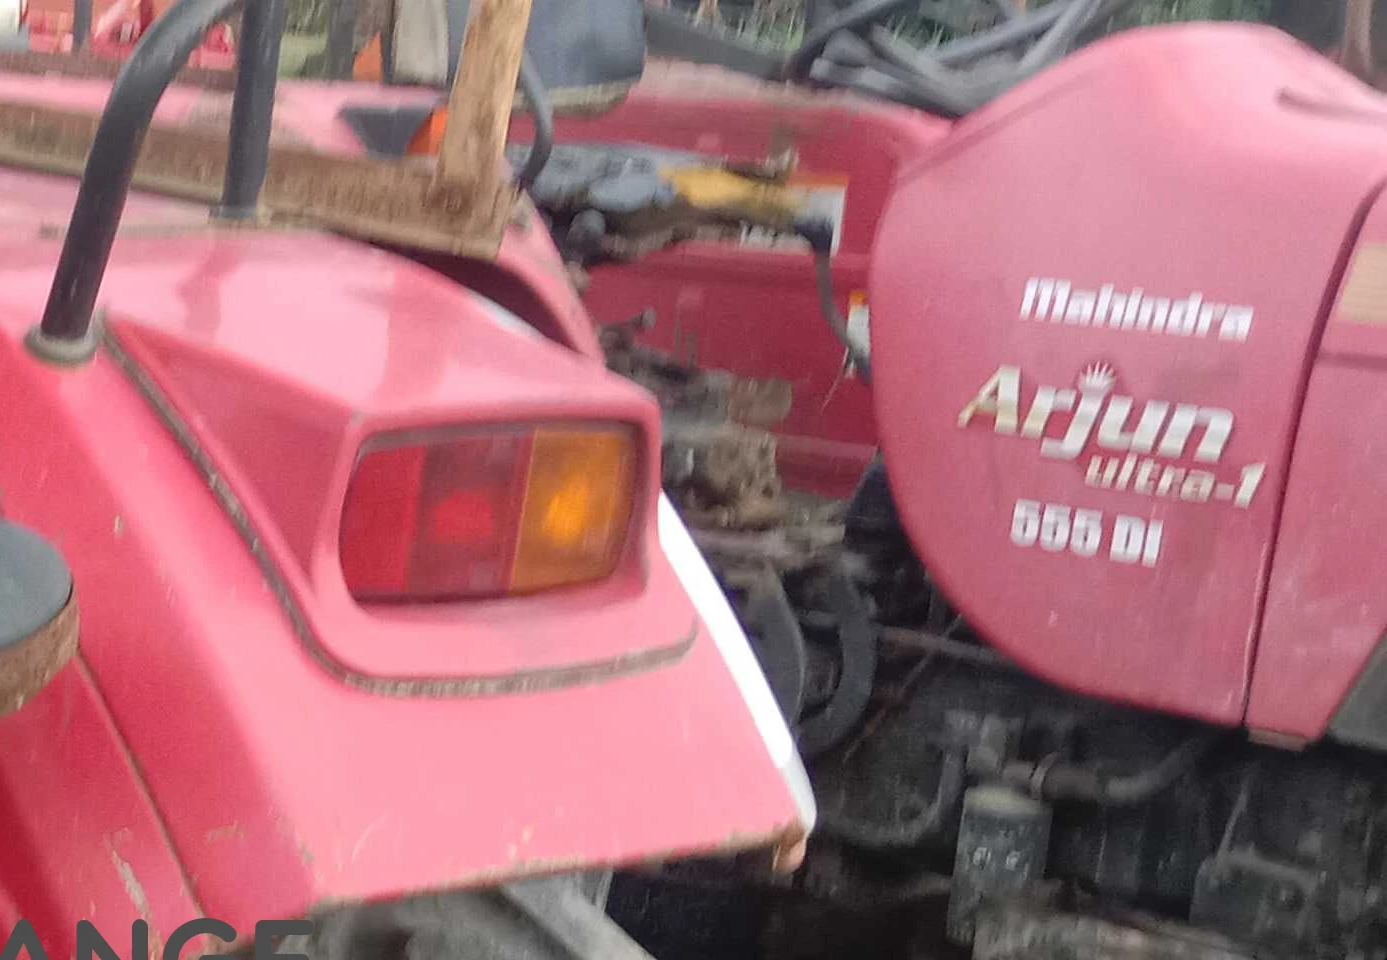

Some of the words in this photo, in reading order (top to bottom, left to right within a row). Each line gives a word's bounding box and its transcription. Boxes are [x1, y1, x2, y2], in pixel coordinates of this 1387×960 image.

[1019, 276, 1254, 344] Mahindra
[957, 362, 1234, 464] Arjun
[1084, 453, 1266, 510] ultra-1
[1010, 498, 1104, 558] 555
[1109, 514, 1164, 568] DI
